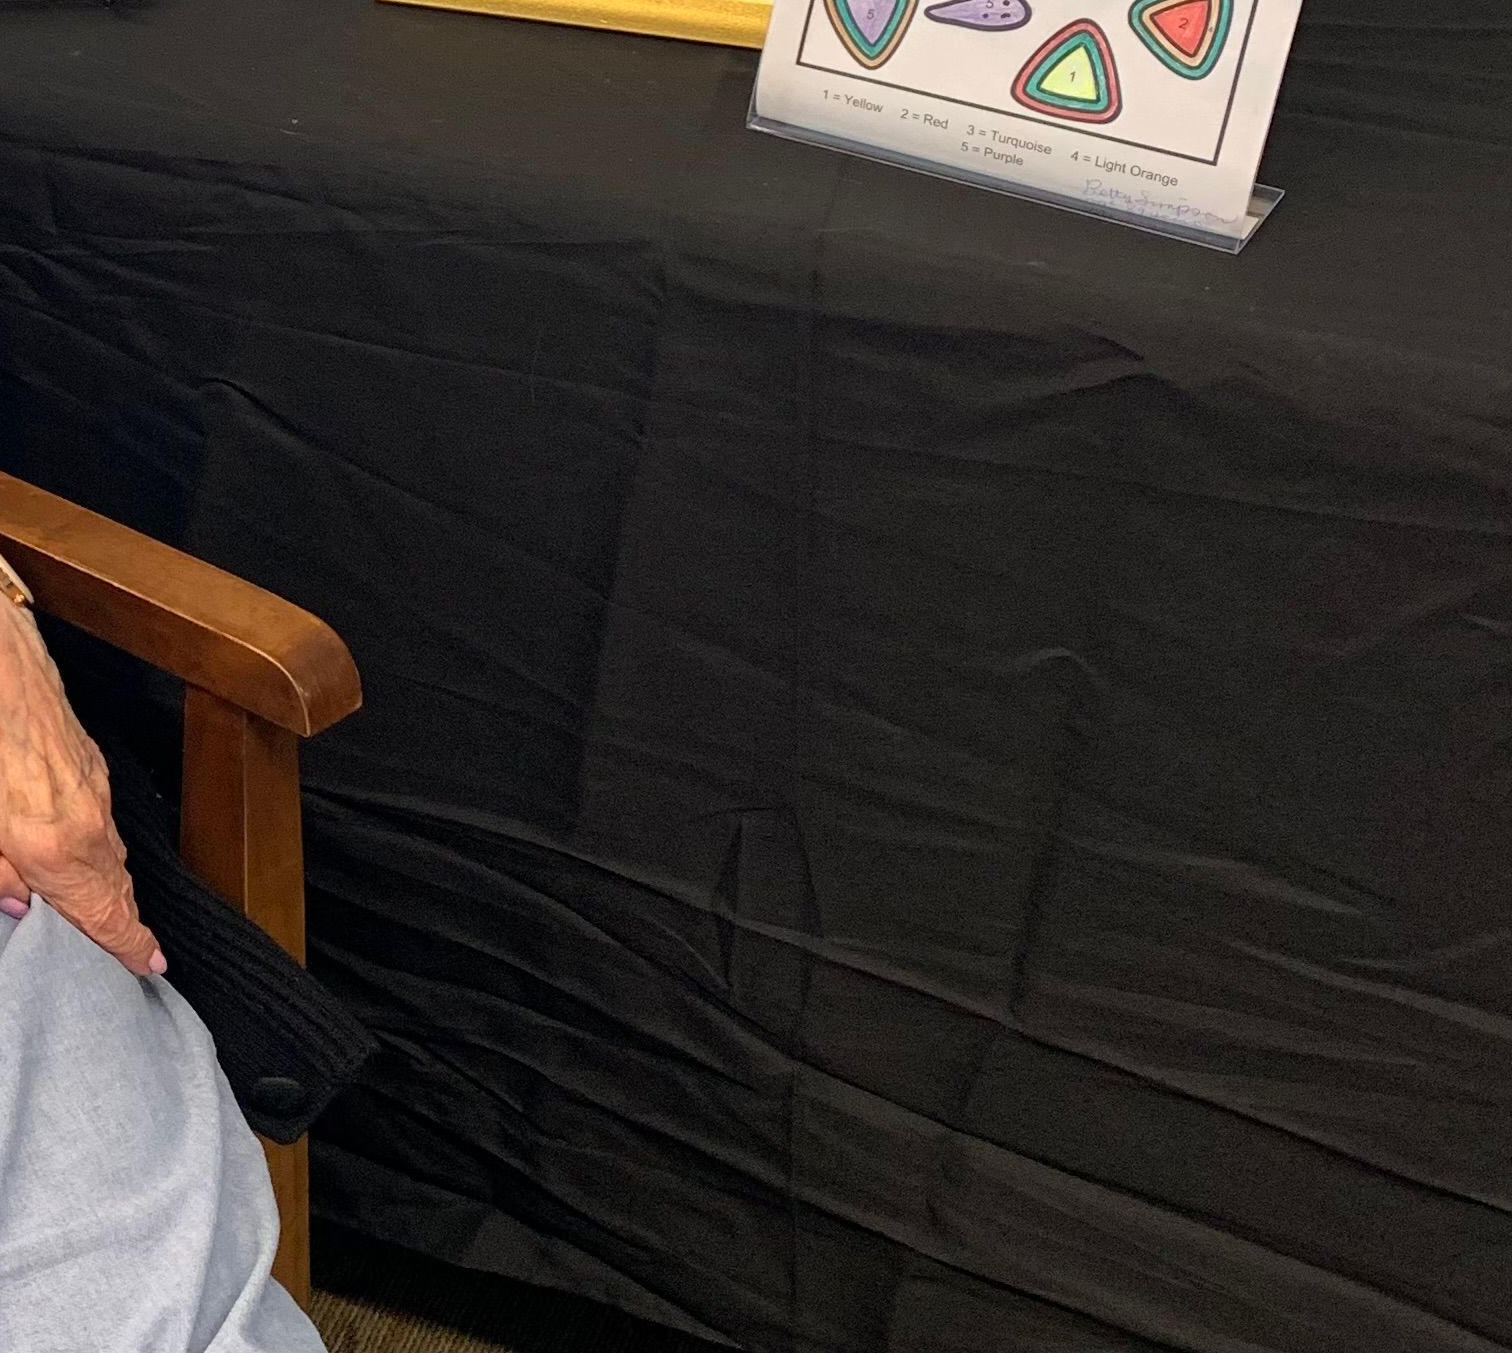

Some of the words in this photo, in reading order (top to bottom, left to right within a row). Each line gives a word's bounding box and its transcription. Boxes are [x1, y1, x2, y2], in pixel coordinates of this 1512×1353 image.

[867, 8, 875, 20] 5
[1179, 18, 1188, 30] 2
[1070, 72, 1076, 82] 1
[823, 90, 829, 99] 1
[844, 94, 884, 113] Yellow
[900, 108, 909, 119] 2
[923, 113, 949, 129] Red
[961, 141, 968, 152] 5
[984, 146, 1024, 166] Purple
[966, 124, 975, 136] 3
[991, 130, 1052, 155] Turquoise
[1070, 151, 1079, 161] 4
[1095, 156, 1126, 173] Light
[1130, 165, 1178, 186] Orange
